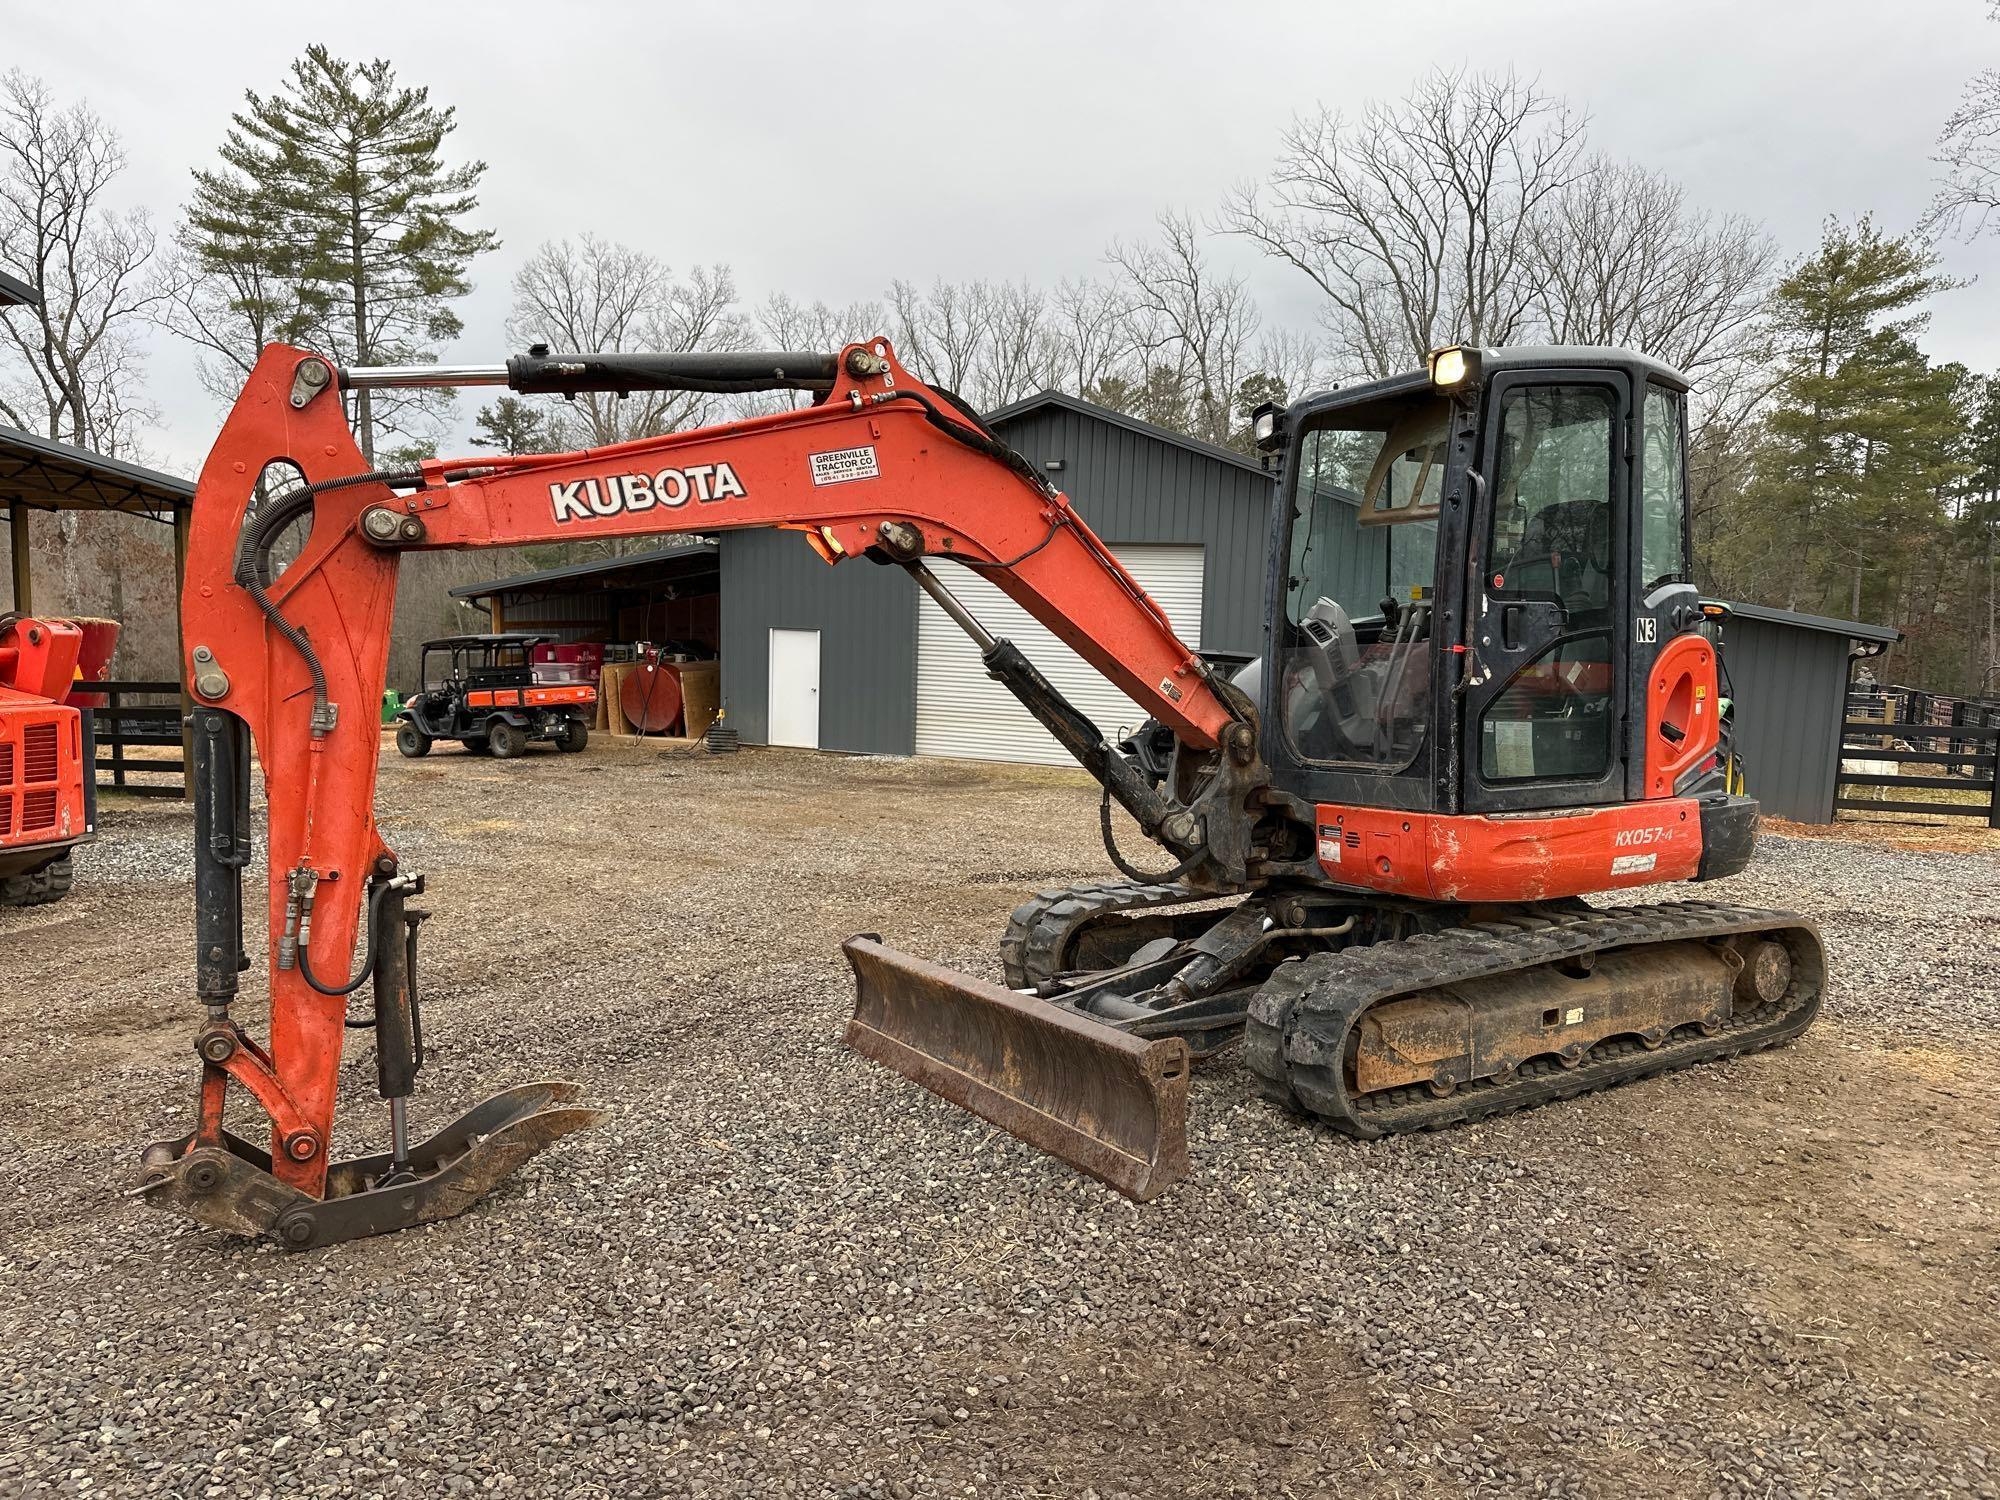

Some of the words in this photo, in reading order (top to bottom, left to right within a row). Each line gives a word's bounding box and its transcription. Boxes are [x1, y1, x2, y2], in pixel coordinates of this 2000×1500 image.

[816, 449, 870, 463] GREENVILLE
[816, 460, 858, 472] TRACTOR
[860, 457, 873, 466] CO
[551, 462, 745, 523] KUBOTA
[1638, 619, 1655, 641] N3
[1615, 826, 1673, 847] KX057-4
